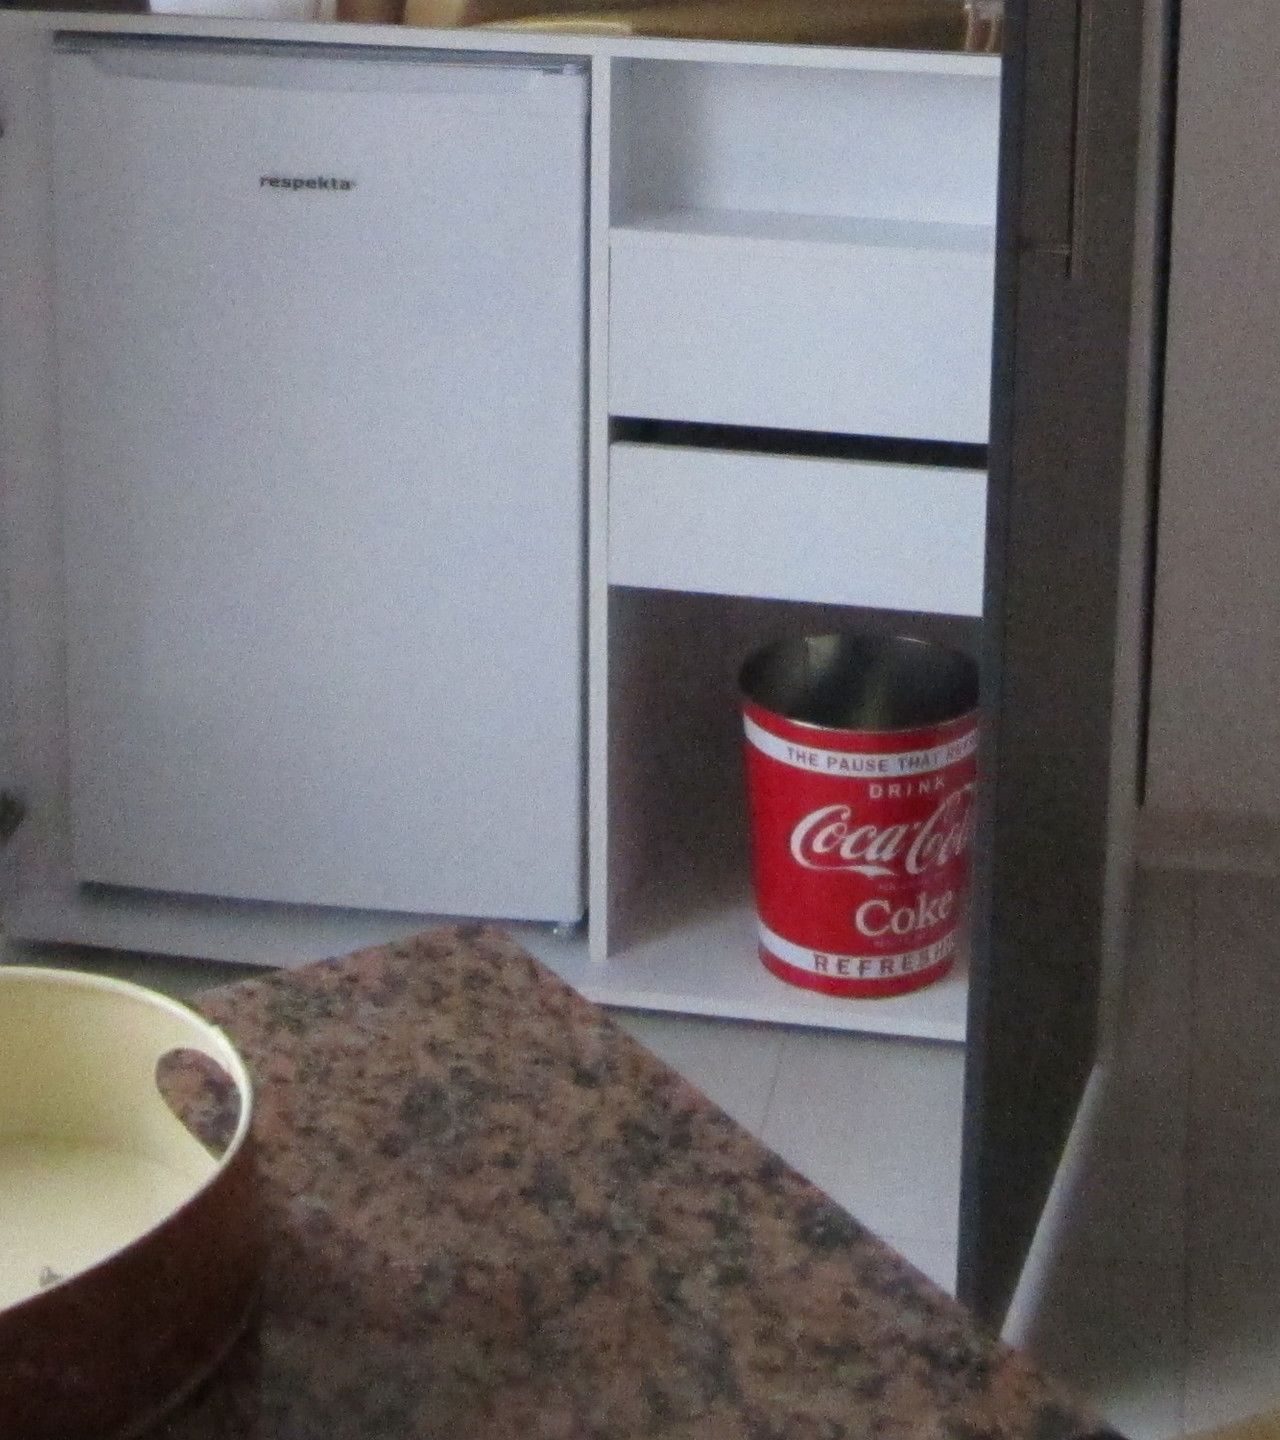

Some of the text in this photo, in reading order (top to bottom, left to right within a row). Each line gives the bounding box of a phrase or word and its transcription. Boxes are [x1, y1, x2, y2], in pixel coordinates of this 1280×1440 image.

[260, 176, 353, 191] respekta
[787, 746, 819, 767] THE
[826, 755, 889, 773] PAUSE
[898, 749, 939, 772] THAT
[870, 776, 945, 799] DRINK
